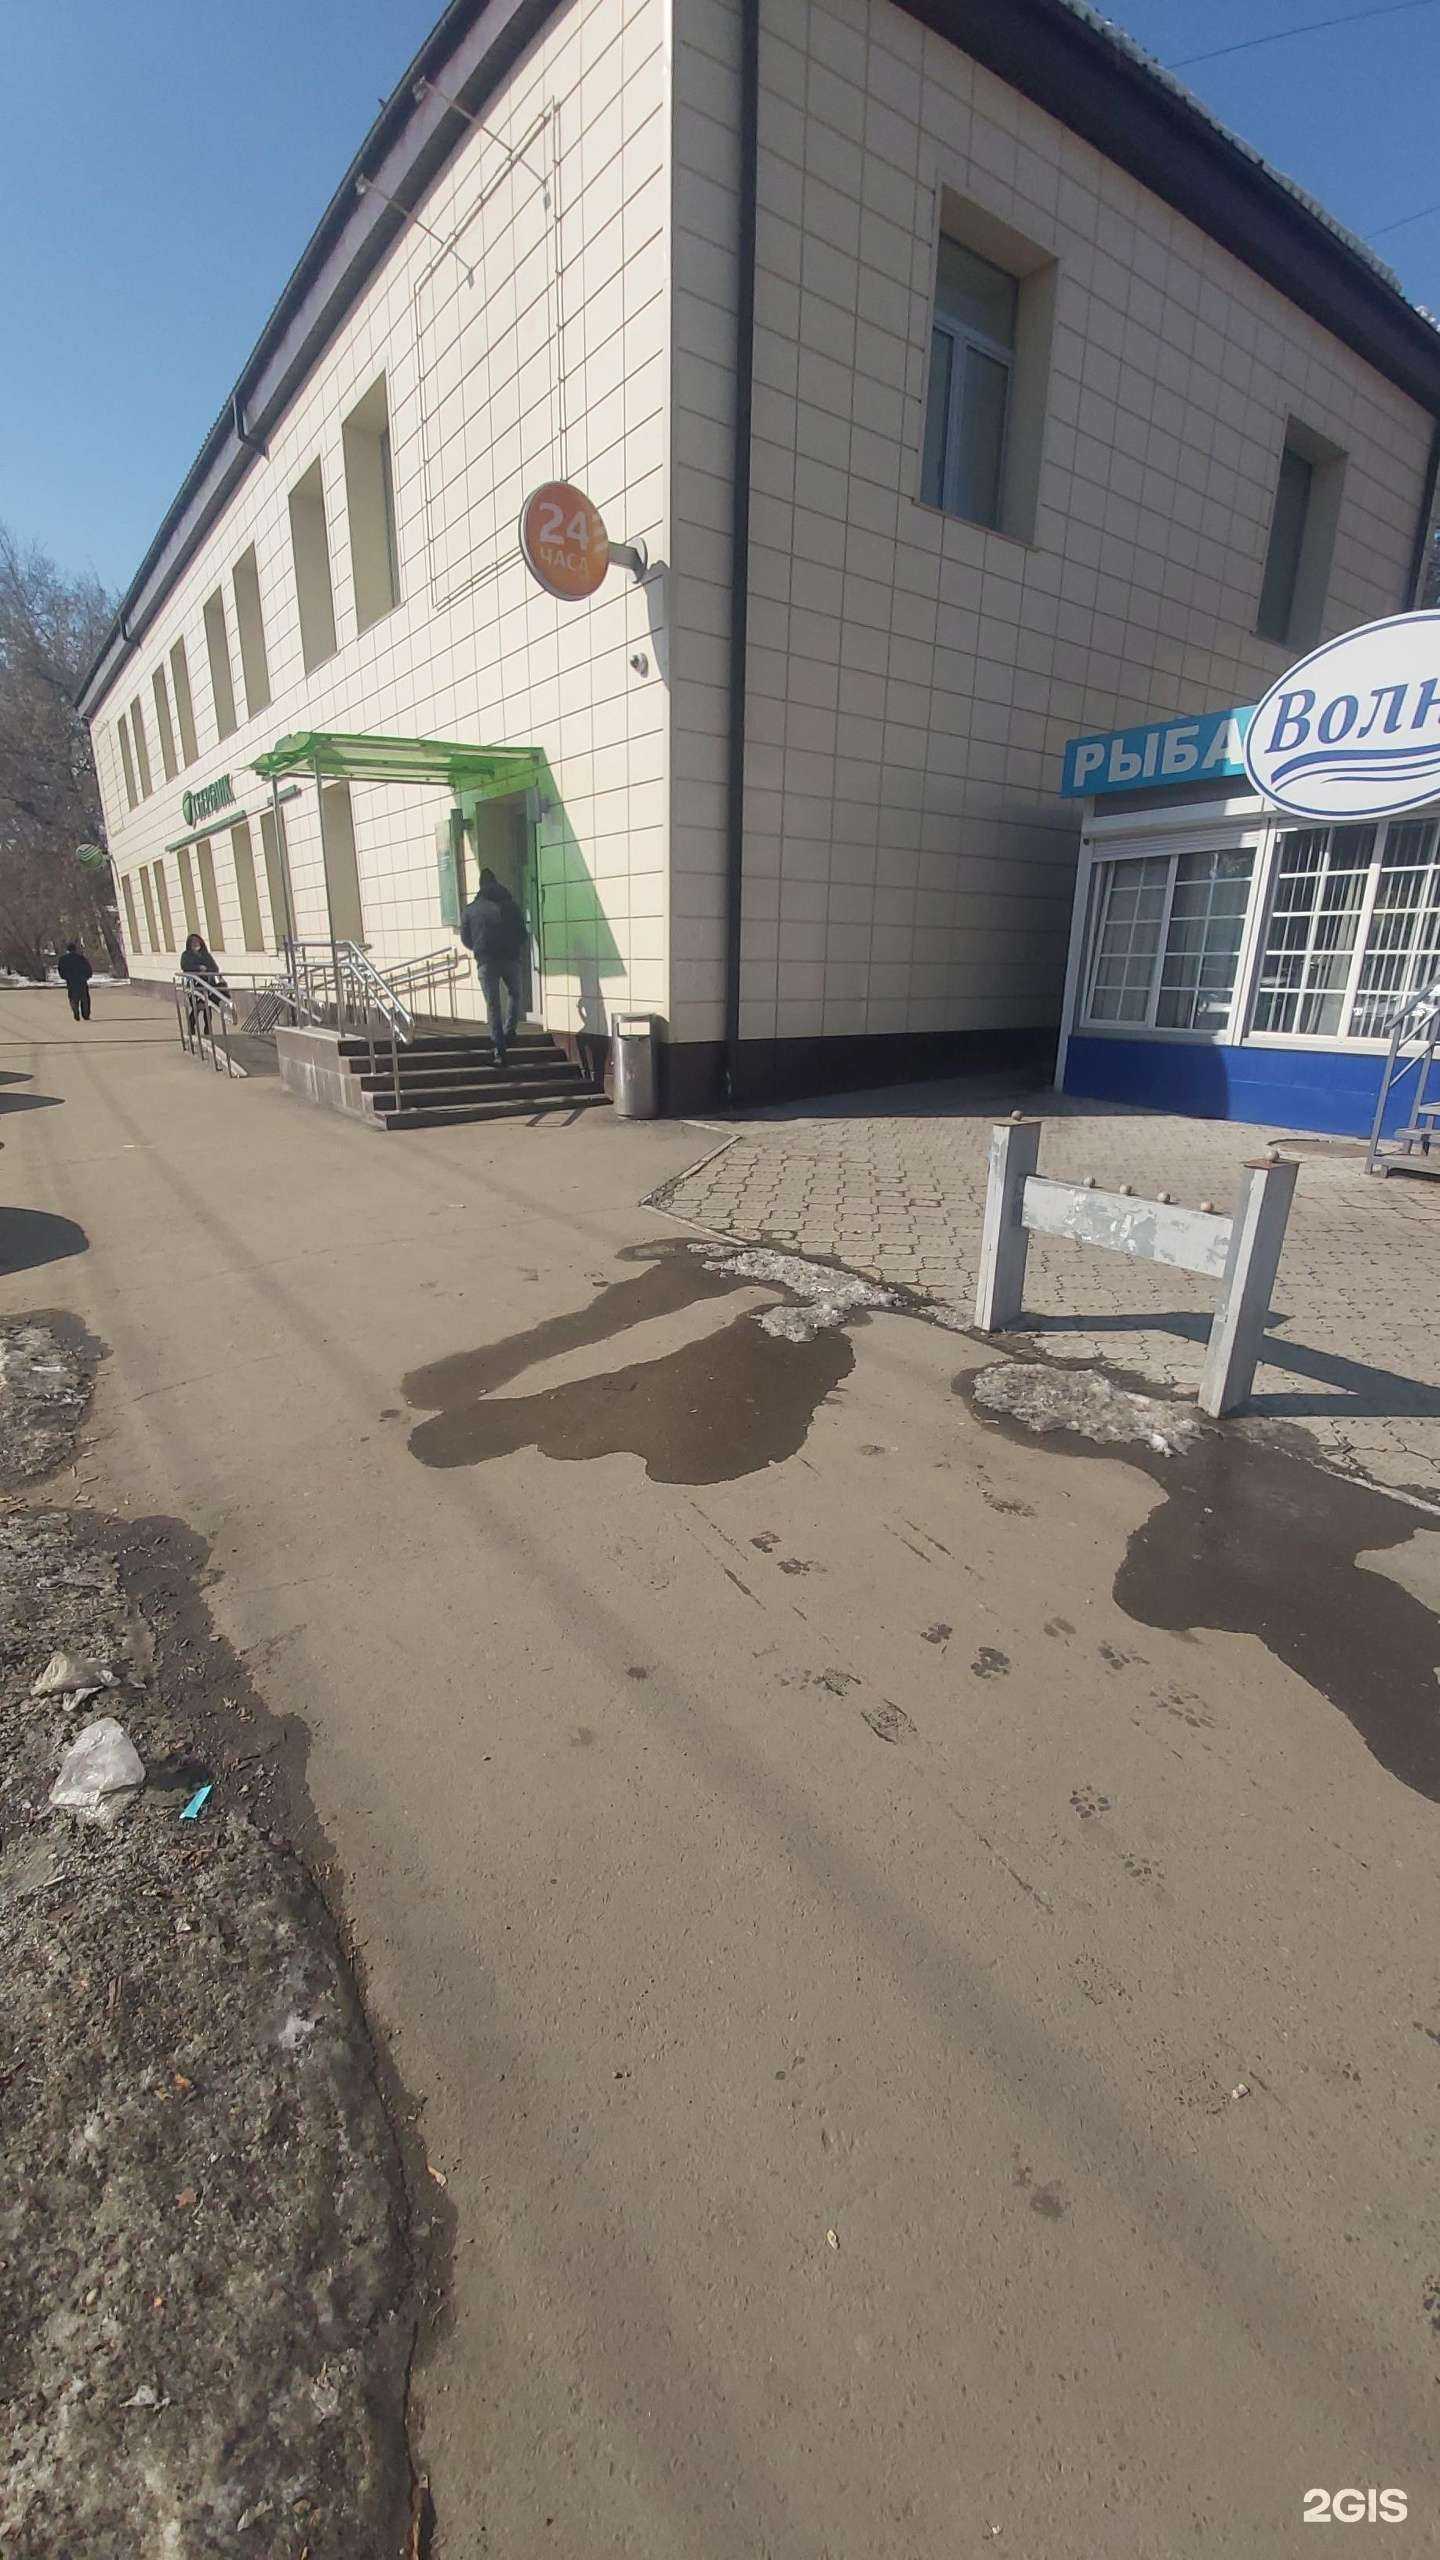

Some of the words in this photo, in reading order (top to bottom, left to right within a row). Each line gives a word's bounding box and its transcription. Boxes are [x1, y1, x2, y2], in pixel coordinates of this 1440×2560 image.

[539, 502, 591, 552] 24
[540, 547, 590, 576] ЧАСА
[1073, 718, 1244, 787] РЫБА
